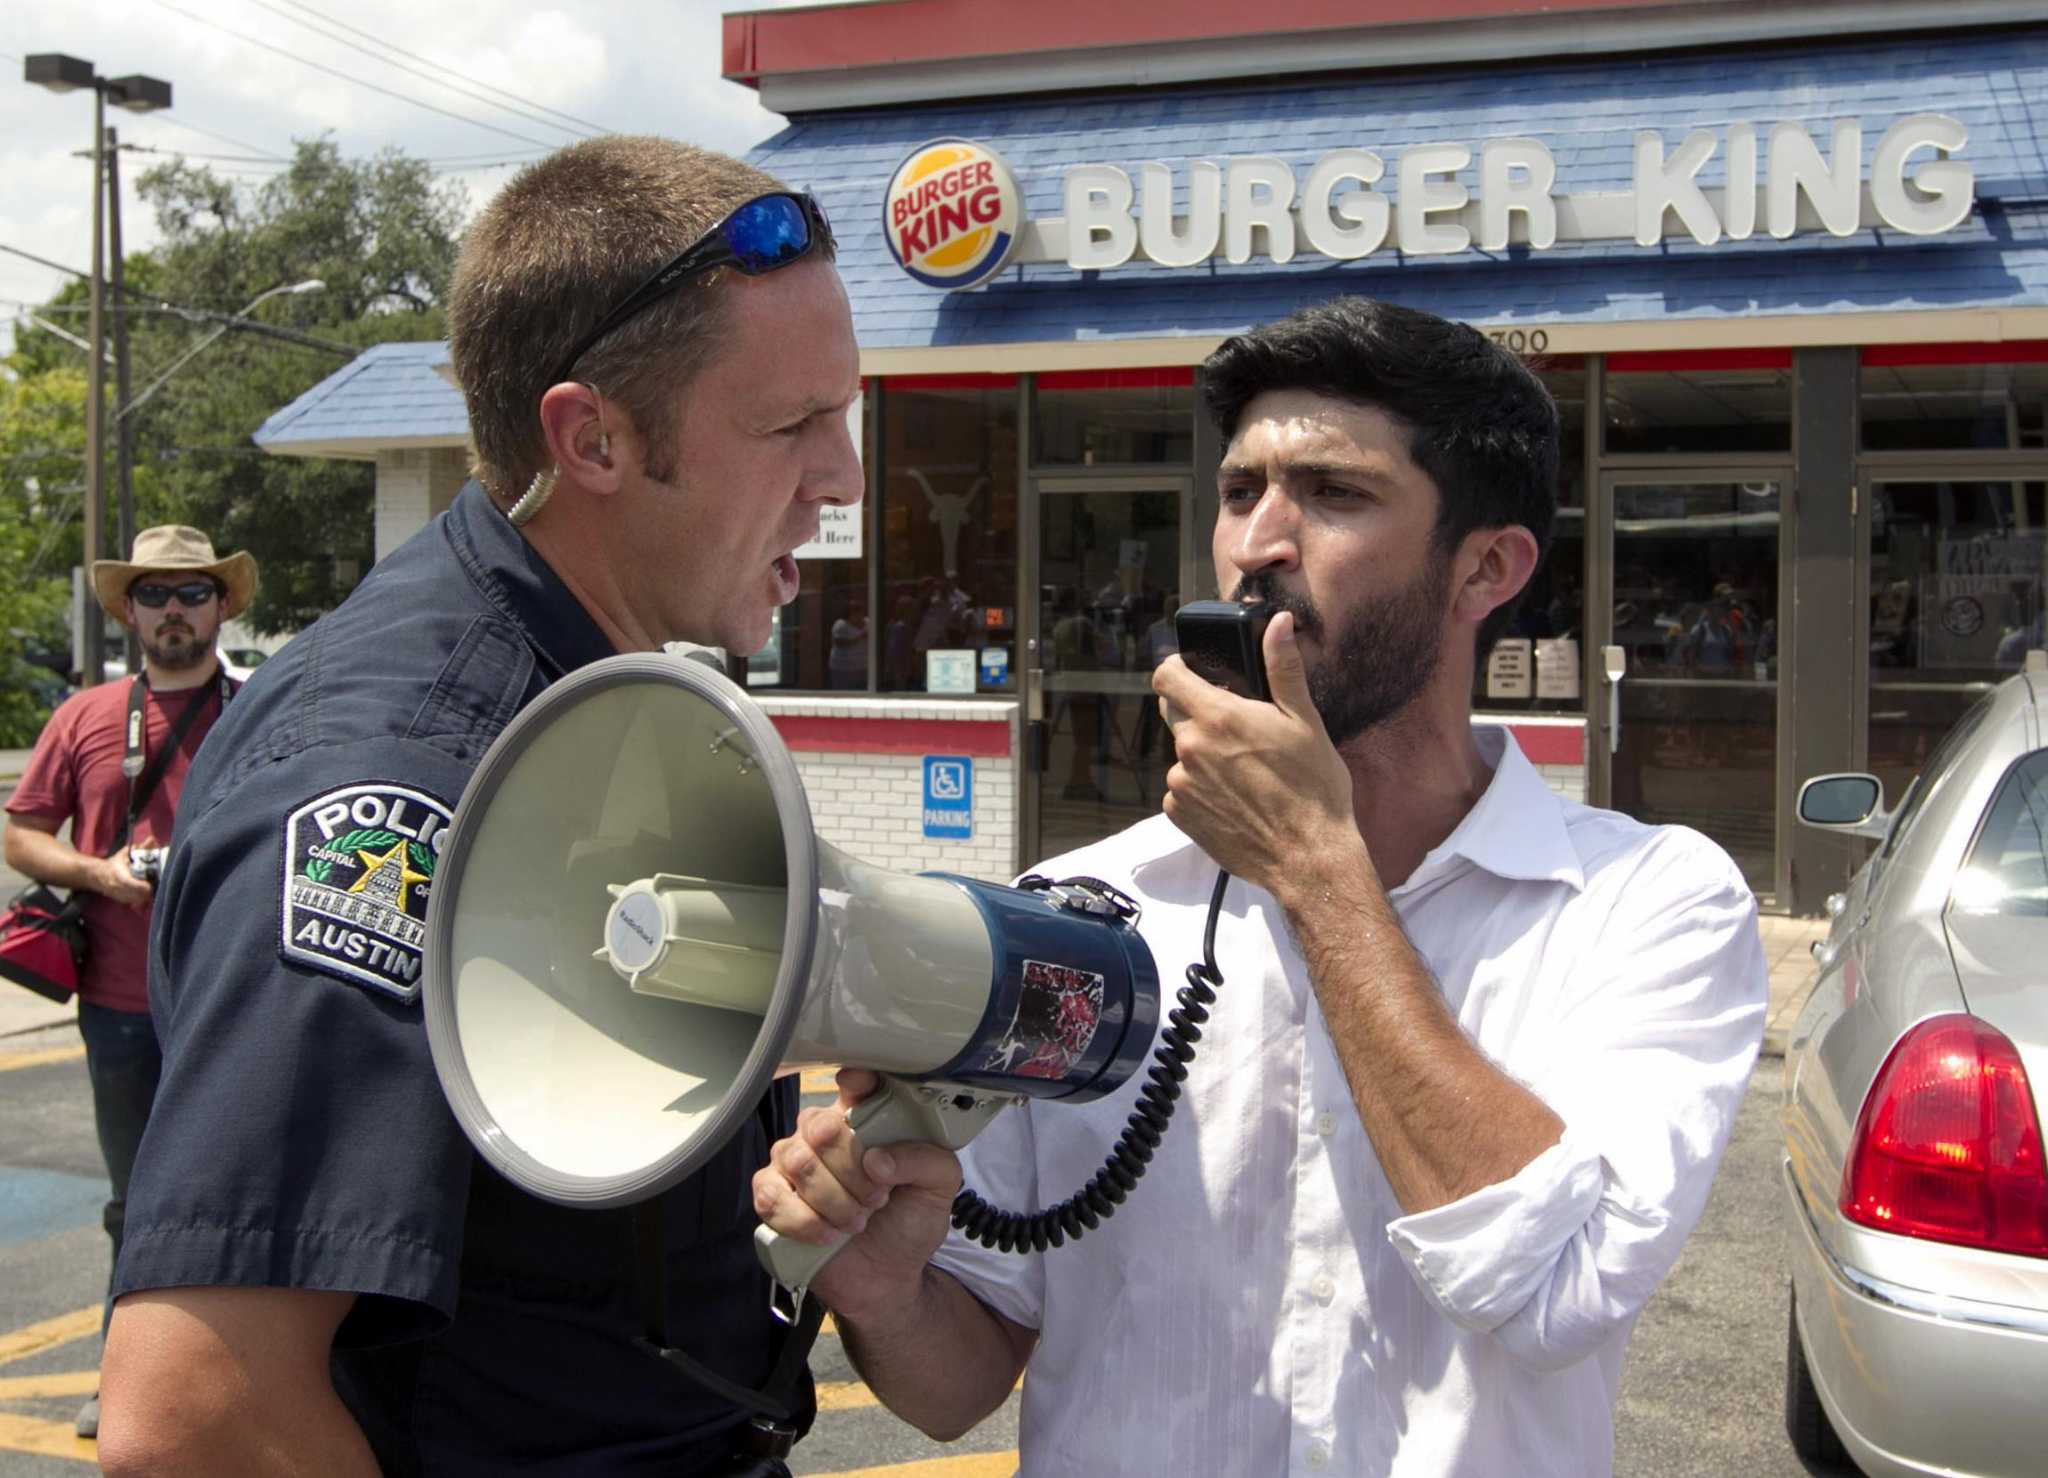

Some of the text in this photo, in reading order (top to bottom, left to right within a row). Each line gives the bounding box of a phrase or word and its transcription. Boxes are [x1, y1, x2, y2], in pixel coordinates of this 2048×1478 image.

[894, 160, 994, 227] BURGER
[1065, 113, 1975, 271] BURGER KING
[901, 186, 1002, 264] KING
[826, 531, 855, 544] Here
[313, 795, 450, 854] POLIC
[296, 918, 421, 980] AUSTIN
